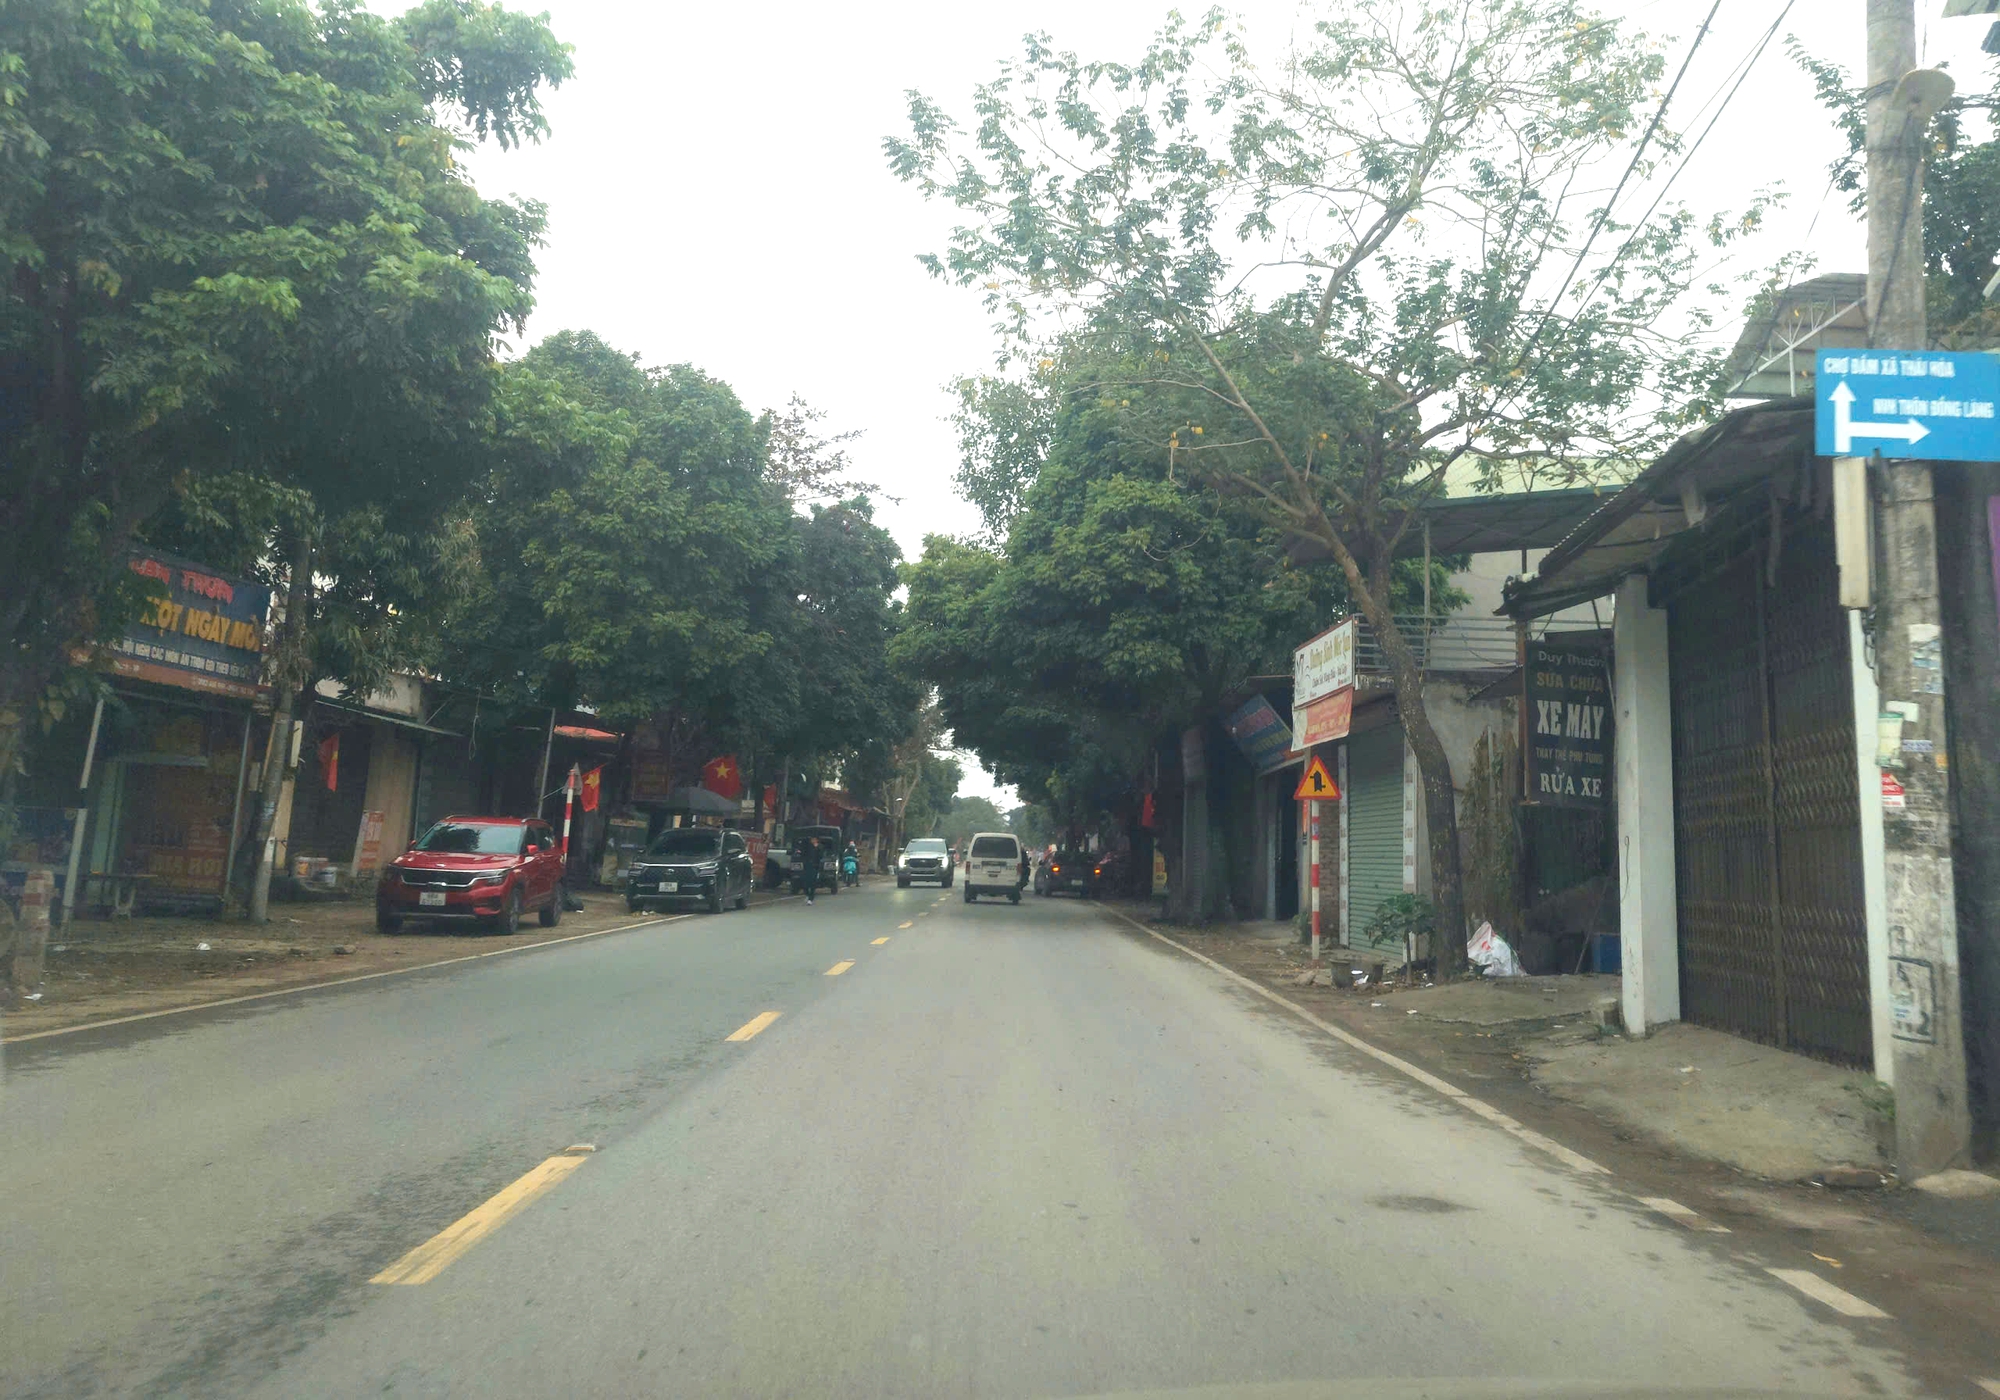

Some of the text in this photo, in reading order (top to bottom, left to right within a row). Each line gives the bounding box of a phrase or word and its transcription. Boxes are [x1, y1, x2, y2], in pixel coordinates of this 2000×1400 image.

[184, 605, 231, 643] NGÀY
[1538, 650, 1563, 666] Duy
[1537, 696, 1604, 740] XE MÁY
[1540, 766, 1602, 798] RỬA XE
